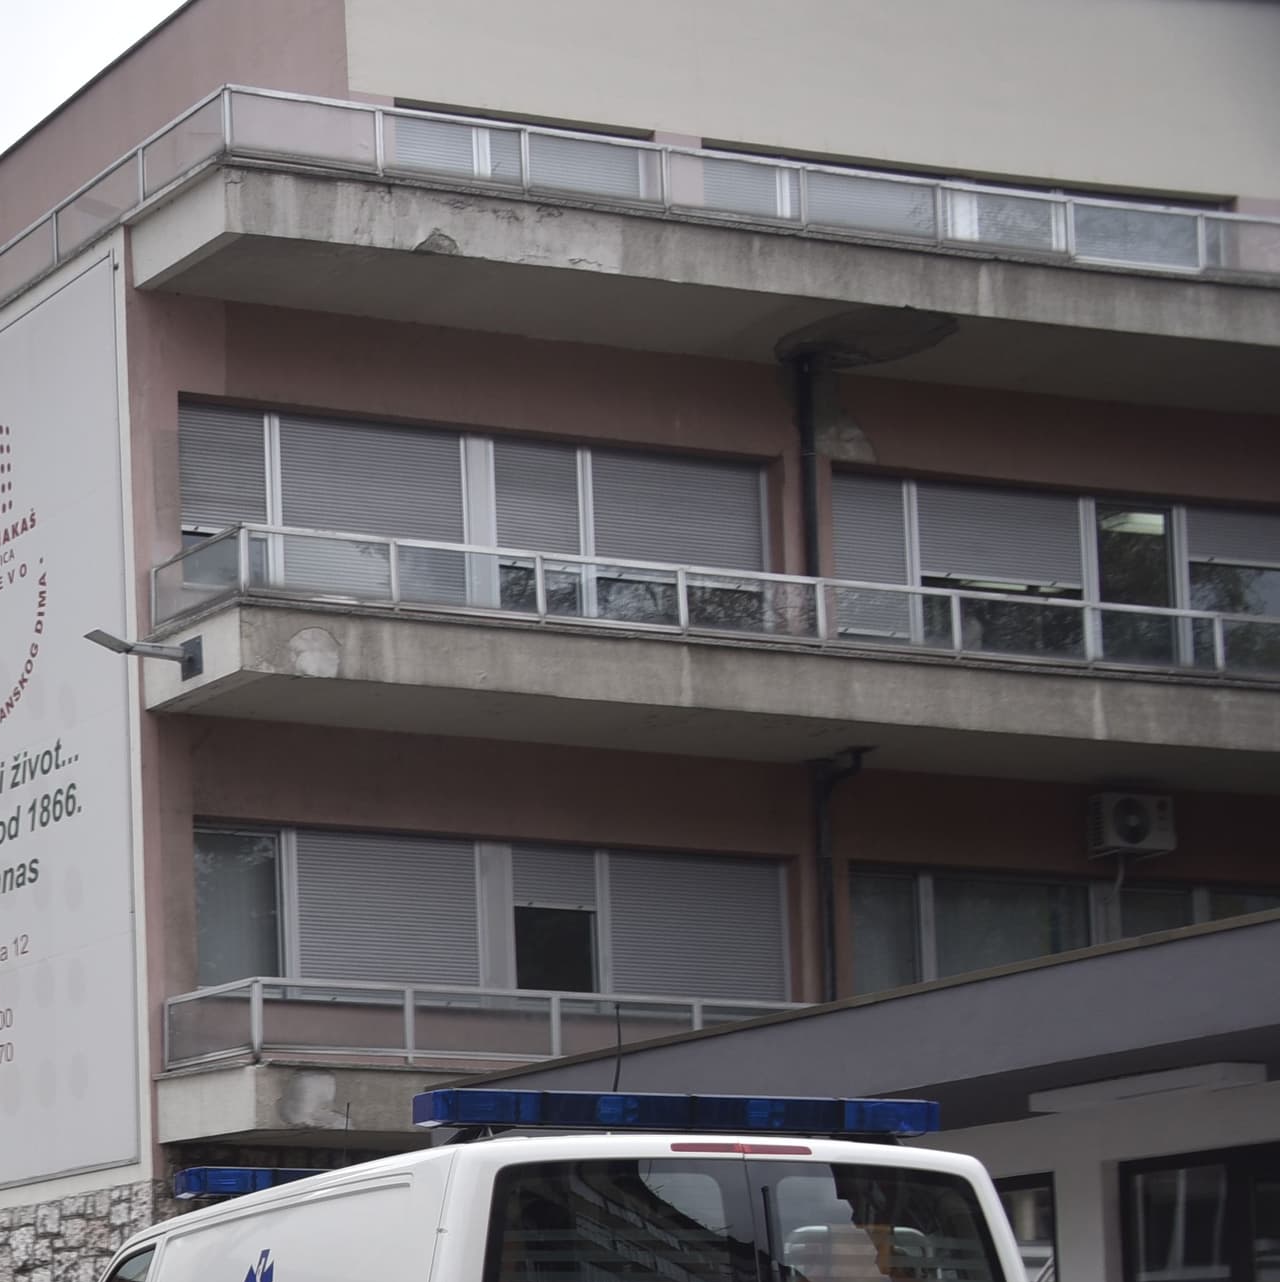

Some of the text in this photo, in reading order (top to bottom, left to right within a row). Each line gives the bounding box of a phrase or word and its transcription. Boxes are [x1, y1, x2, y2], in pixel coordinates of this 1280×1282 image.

[34, 571, 47, 635] DIMA
[10, 738, 80, 790] život...
[27, 782, 83, 833] 1866.
[13, 933, 30, 957] 12
